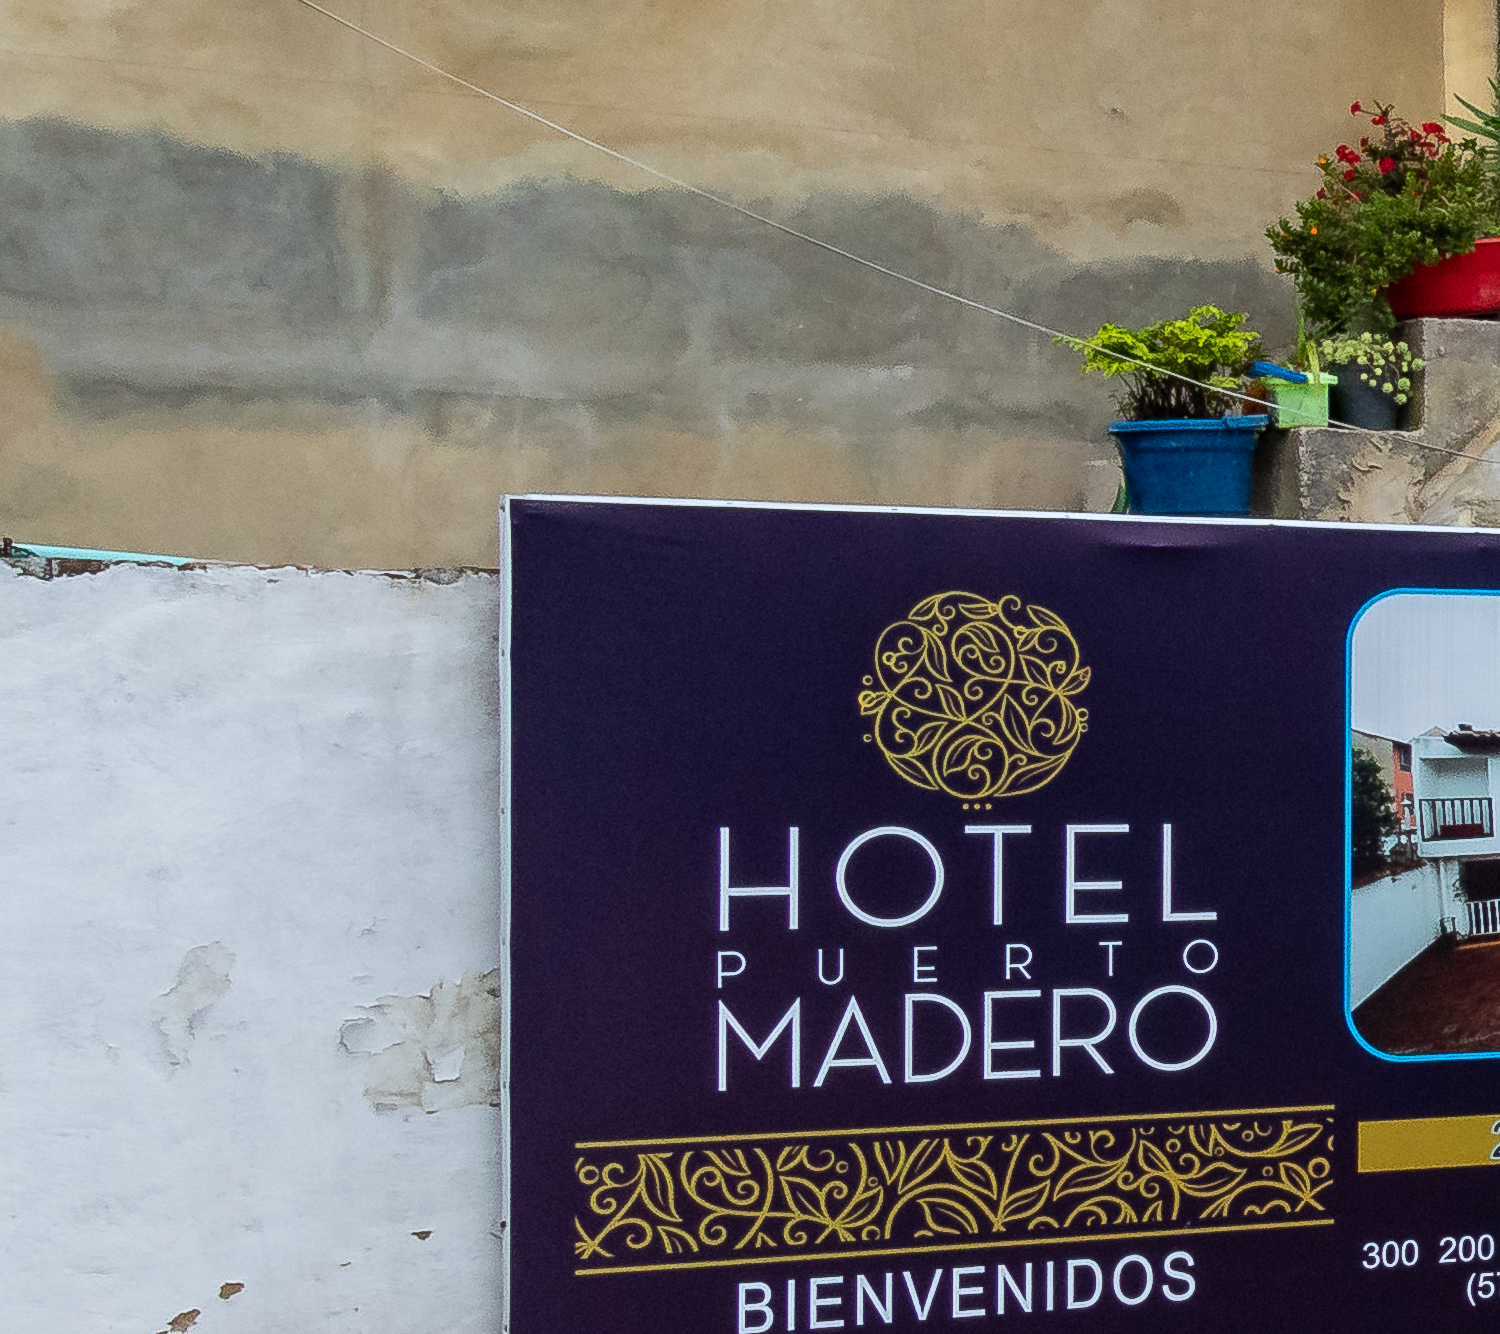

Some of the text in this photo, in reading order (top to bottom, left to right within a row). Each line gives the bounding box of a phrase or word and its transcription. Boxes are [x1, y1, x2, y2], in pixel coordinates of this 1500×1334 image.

[718, 823, 1218, 932] HOTEL
[717, 939, 1219, 989] PUERTO
[718, 984, 1218, 1092] MADERO
[1362, 1240, 1419, 1270] 300
[1438, 1233, 1495, 1264] 200
